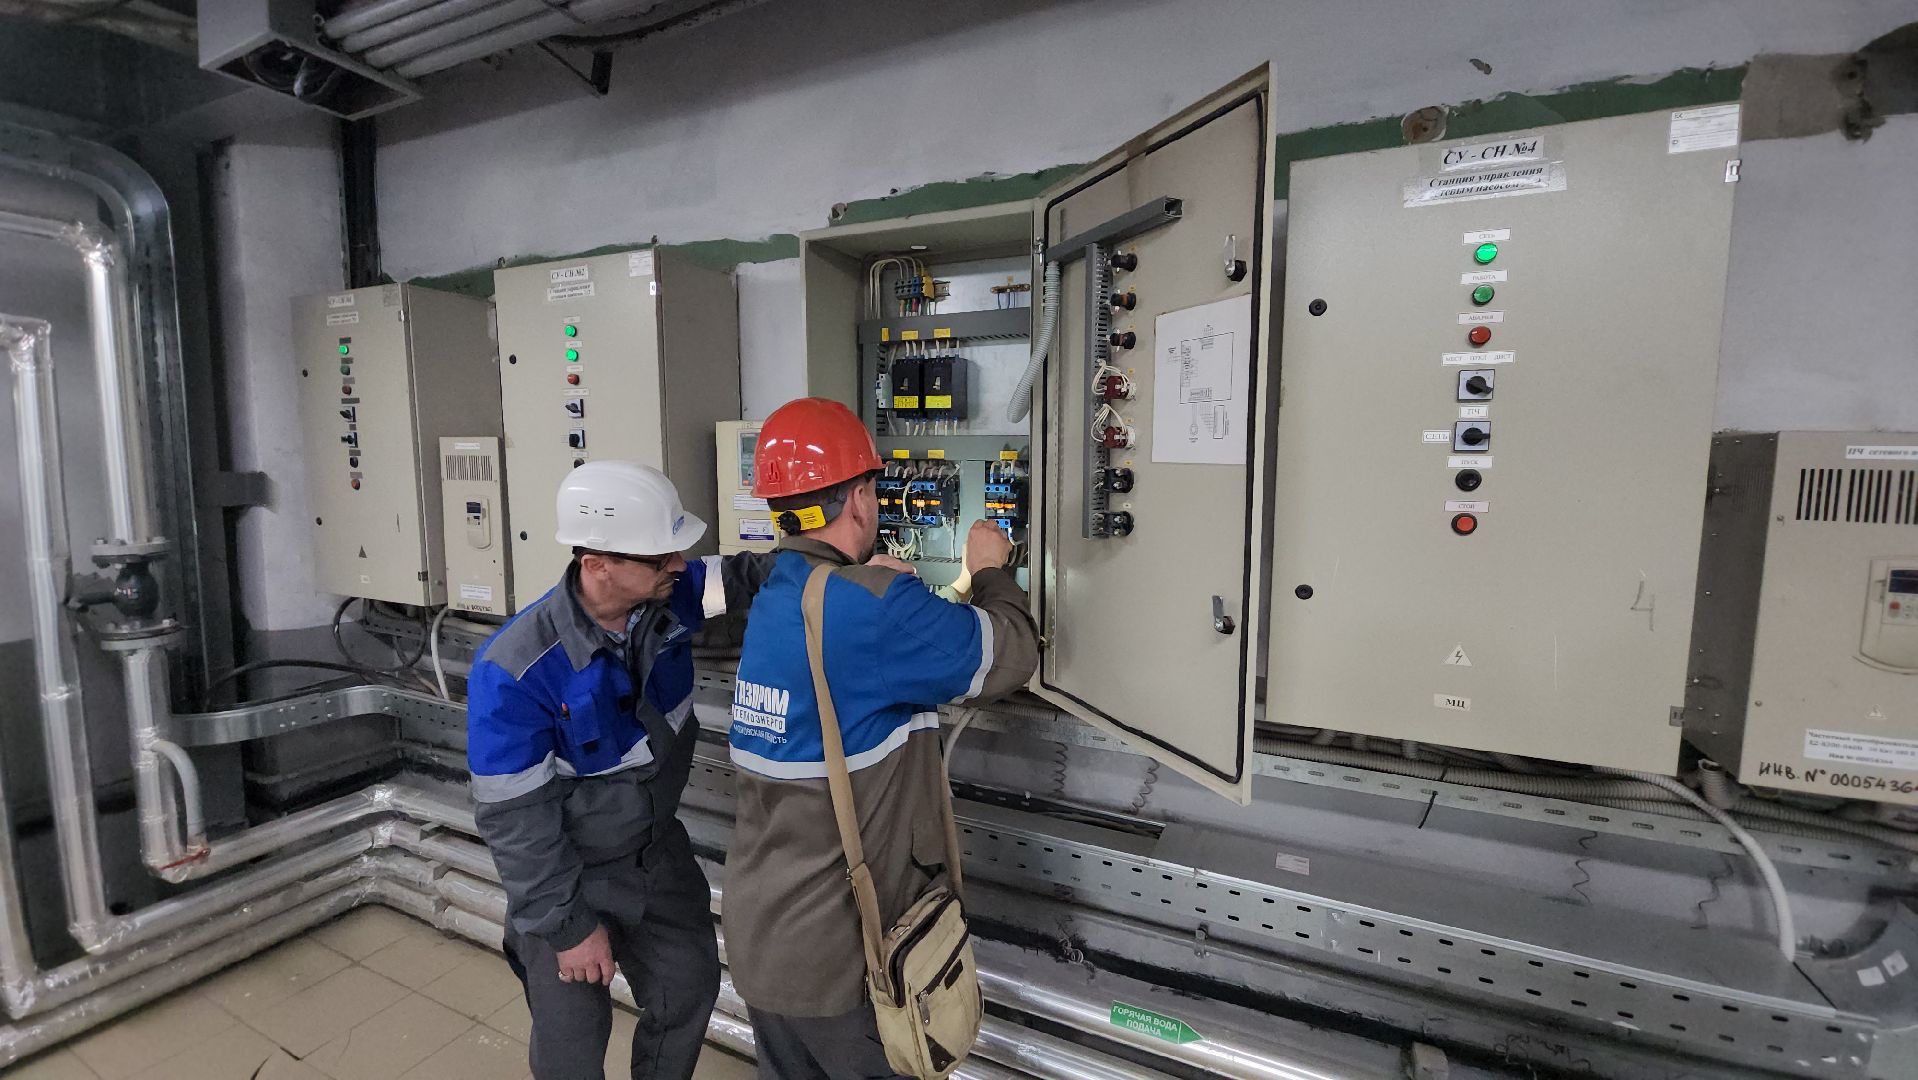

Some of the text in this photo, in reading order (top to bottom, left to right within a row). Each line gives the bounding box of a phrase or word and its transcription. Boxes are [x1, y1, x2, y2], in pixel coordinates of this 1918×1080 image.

[1443, 150, 1468, 165] СУ
[1481, 144, 1507, 160] СН
[1509, 140, 1538, 156] №4
[1429, 167, 1544, 188] Станция управления
[734, 680, 790, 716] ГАЗПРОМ
[1113, 1005, 1178, 1032] ГОРЯЧАЯ ВОДА
[1126, 1019, 1162, 1037] ПОДАЧА
